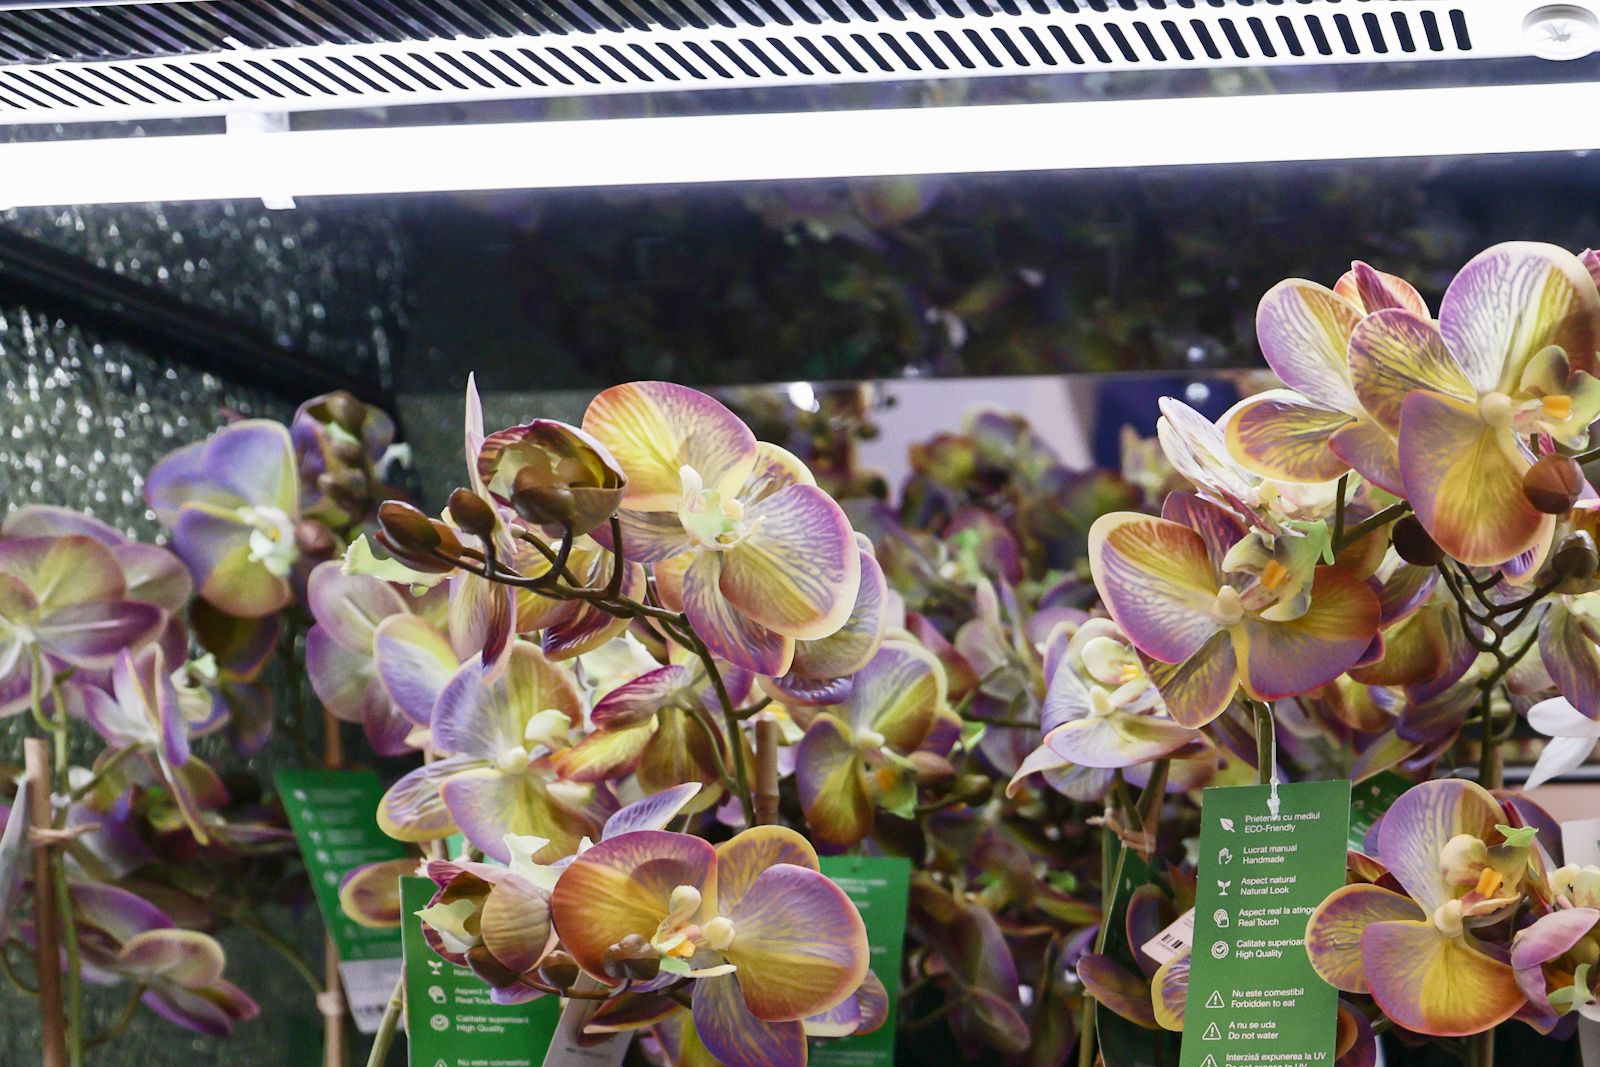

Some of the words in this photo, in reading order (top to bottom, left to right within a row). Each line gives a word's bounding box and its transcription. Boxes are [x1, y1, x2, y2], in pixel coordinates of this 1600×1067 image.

[1294, 812, 1321, 820] mediul
[1244, 824, 1296, 833] ECO-Friendly
[1243, 846, 1268, 854] Lucrat
[1269, 844, 1298, 853] manual
[1242, 855, 1285, 864] Handmade
[1241, 876, 1268, 886] Aspect
[1269, 875, 1297, 884] natural
[1240, 886, 1269, 895] Natural
[1269, 886, 1290, 894] Look
[1238, 908, 1266, 917] Aspect
[1267, 907, 1282, 915] real
[1238, 918, 1256, 927] Real
[1256, 918, 1280, 926] Touch
[1236, 940, 1267, 948] Calitate
[1235, 950, 1254, 960] High
[1255, 949, 1284, 959] Quality
[1232, 989, 1244, 998] Nu
[1263, 988, 1305, 997] comestibil
[1231, 999, 1271, 1008] Forbidden
[1282, 999, 1296, 1007] eat
[1228, 1021, 1236, 1029] A
[1260, 1021, 1276, 1029] uda
[1228, 1032, 1240, 1040] Do
[1261, 1053, 1303, 1062] expunerea
[1304, 1052, 1312, 1060] la
[1313, 1052, 1327, 1060] UV
